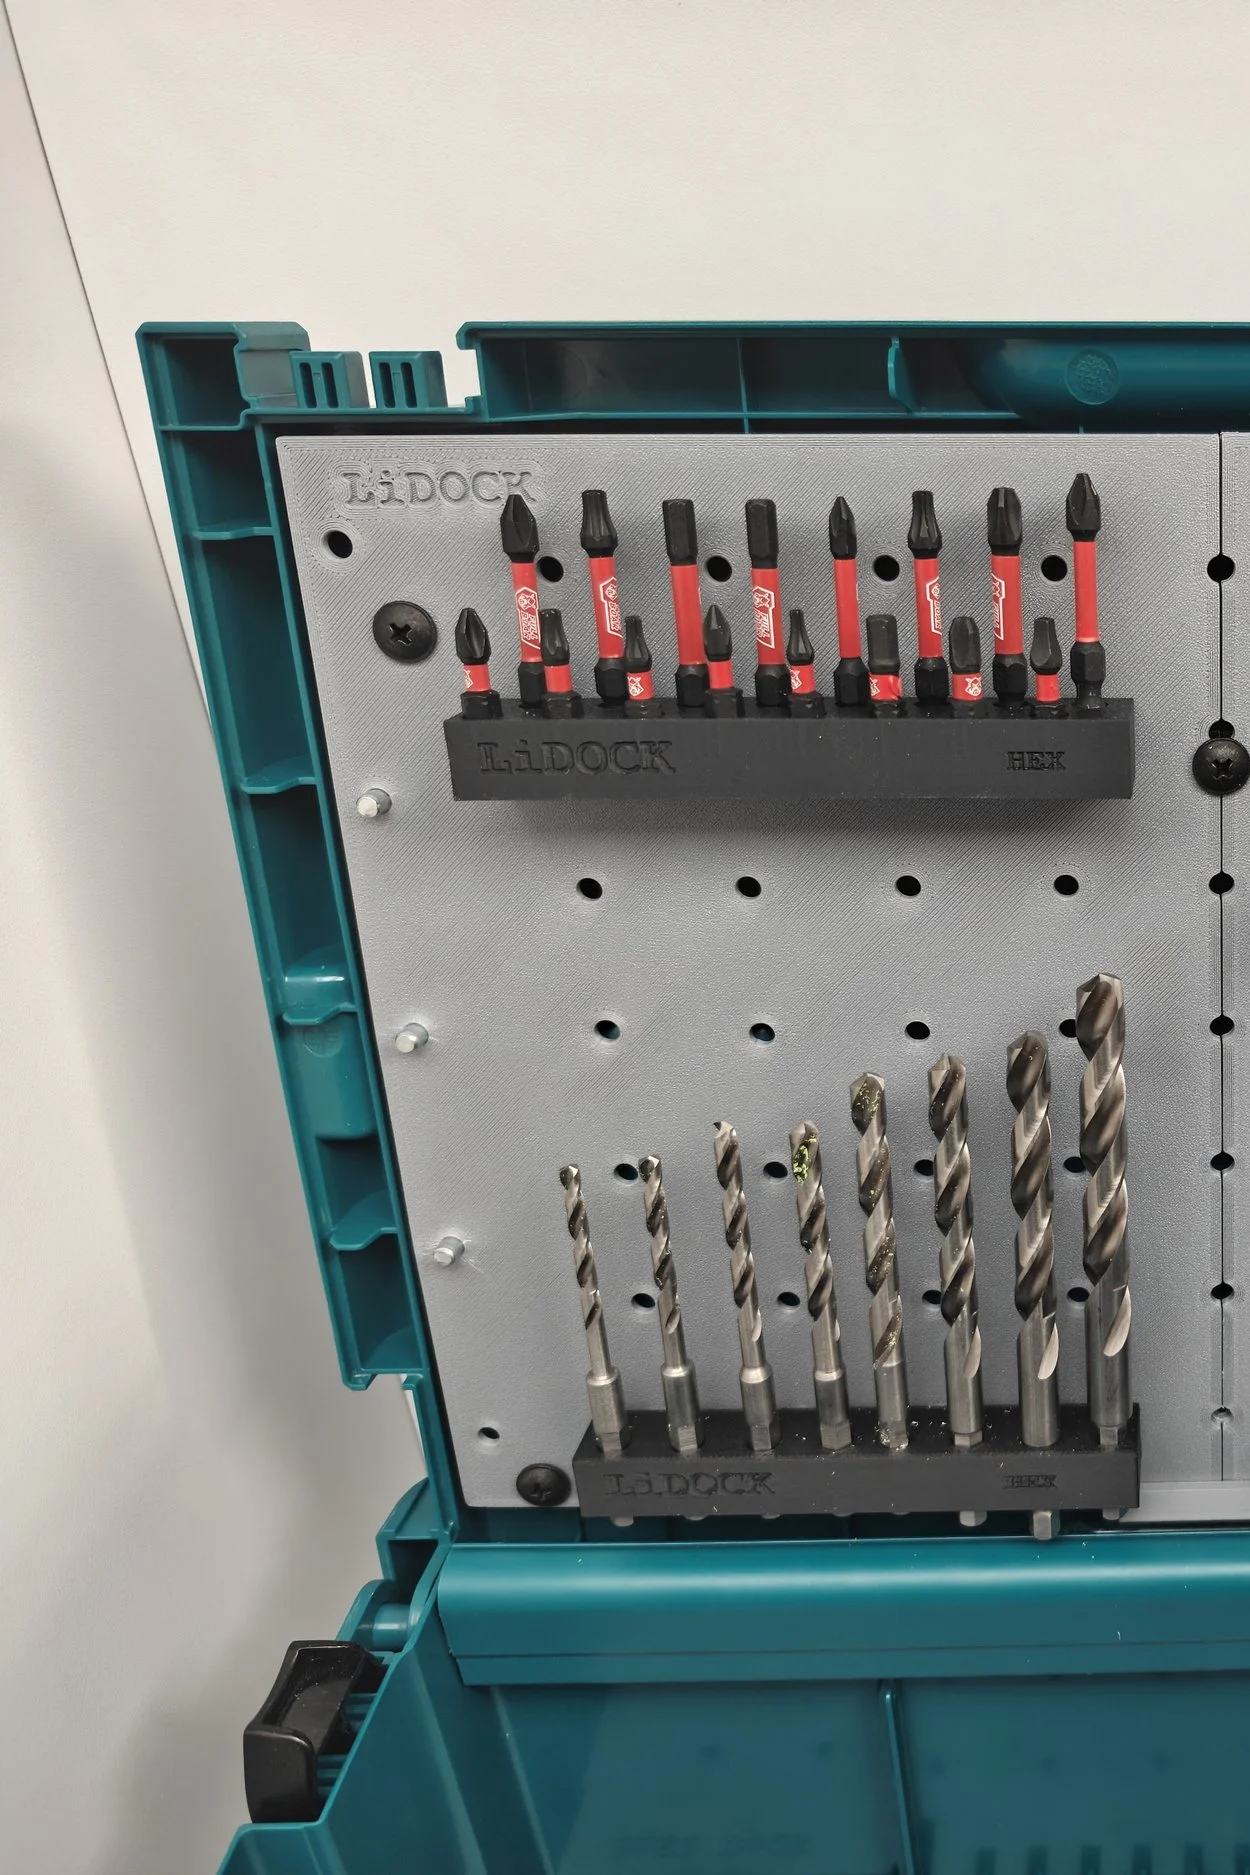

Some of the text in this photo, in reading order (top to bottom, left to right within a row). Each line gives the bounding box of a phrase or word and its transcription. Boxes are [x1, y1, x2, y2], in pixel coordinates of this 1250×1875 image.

[341, 469, 538, 504] LiDOCK
[476, 738, 1067, 776] LiDOCK HEX
[602, 1471, 776, 1497] LiDOCK
